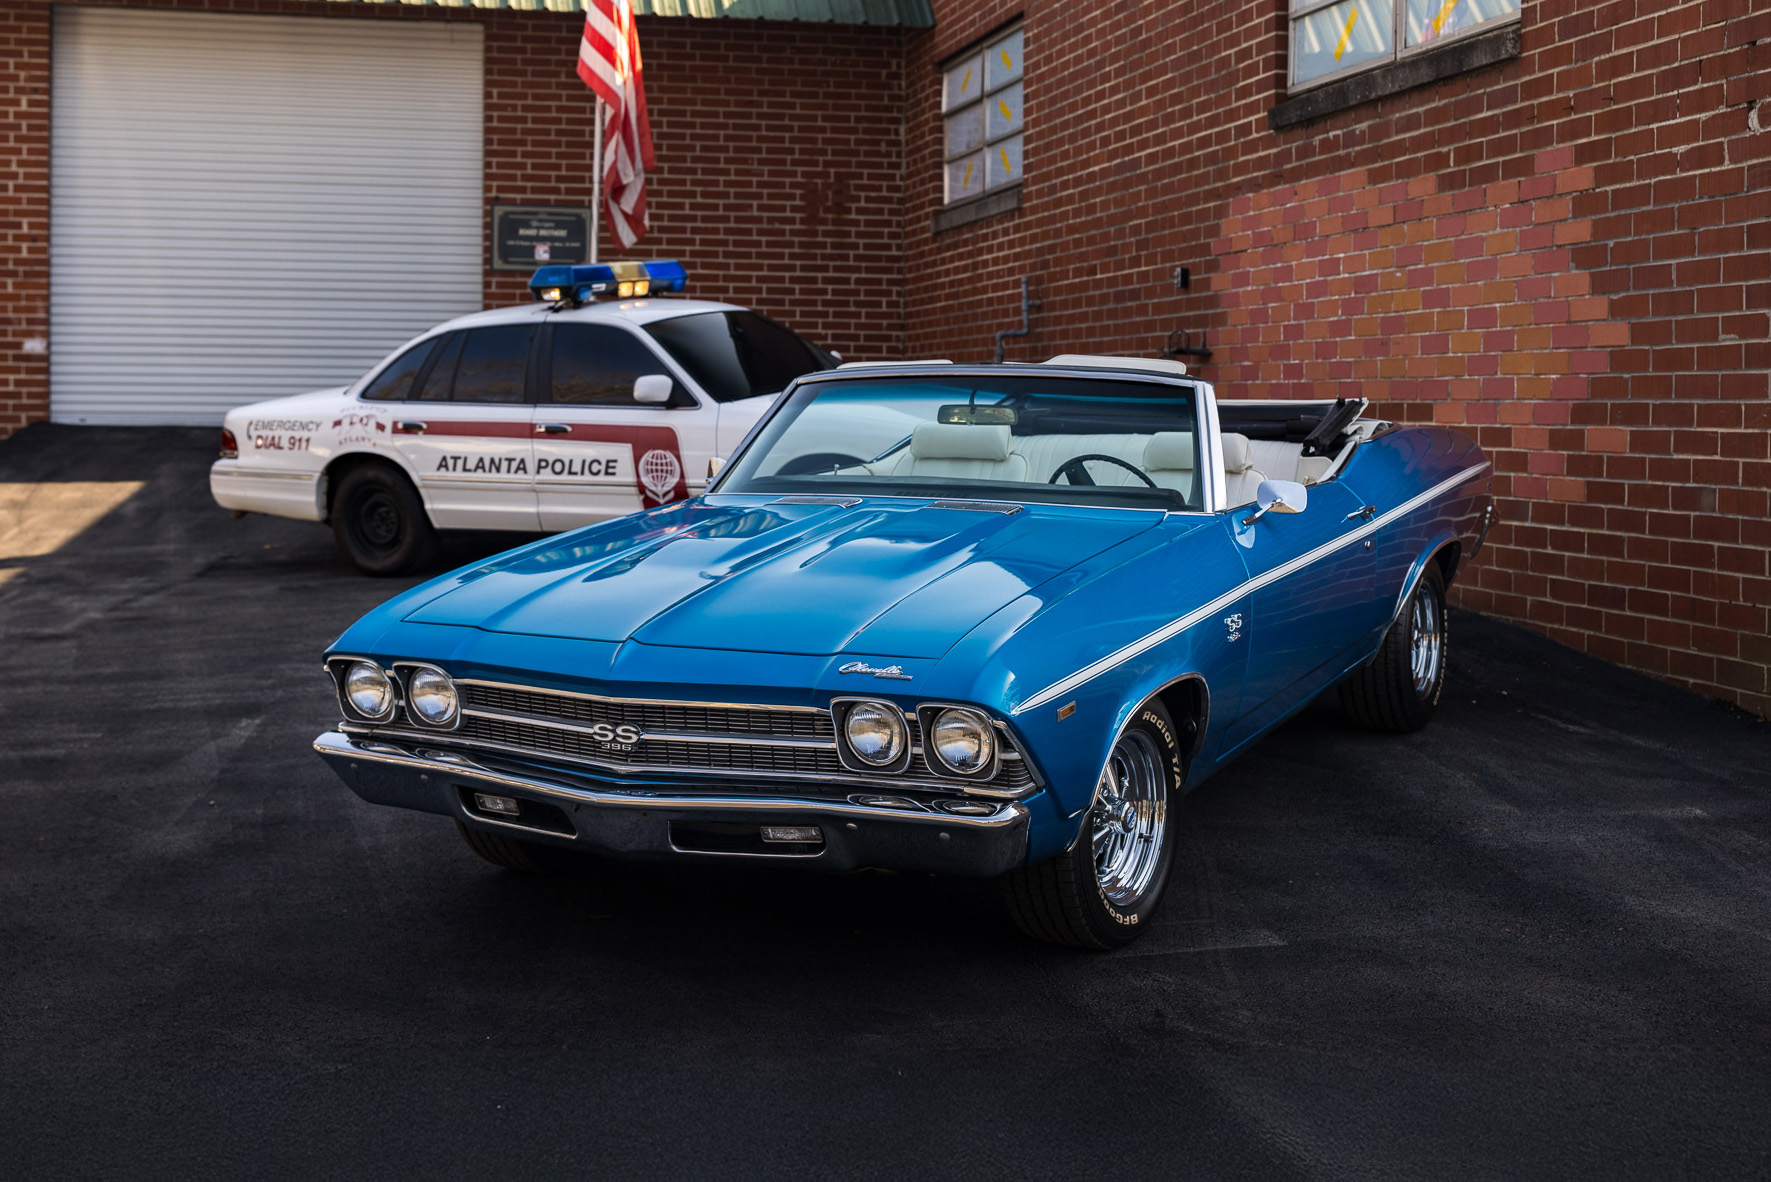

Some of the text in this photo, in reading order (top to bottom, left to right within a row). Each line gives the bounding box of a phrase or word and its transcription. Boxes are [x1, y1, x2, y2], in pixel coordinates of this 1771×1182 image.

[254, 420, 322, 431] EMERGENCY
[255, 434, 311, 451] DIAL 911
[437, 455, 618, 476] ATLANTA POLICE
[592, 723, 639, 743] SS
[601, 742, 632, 752] 396
[1171, 753, 1182, 790] T/A
